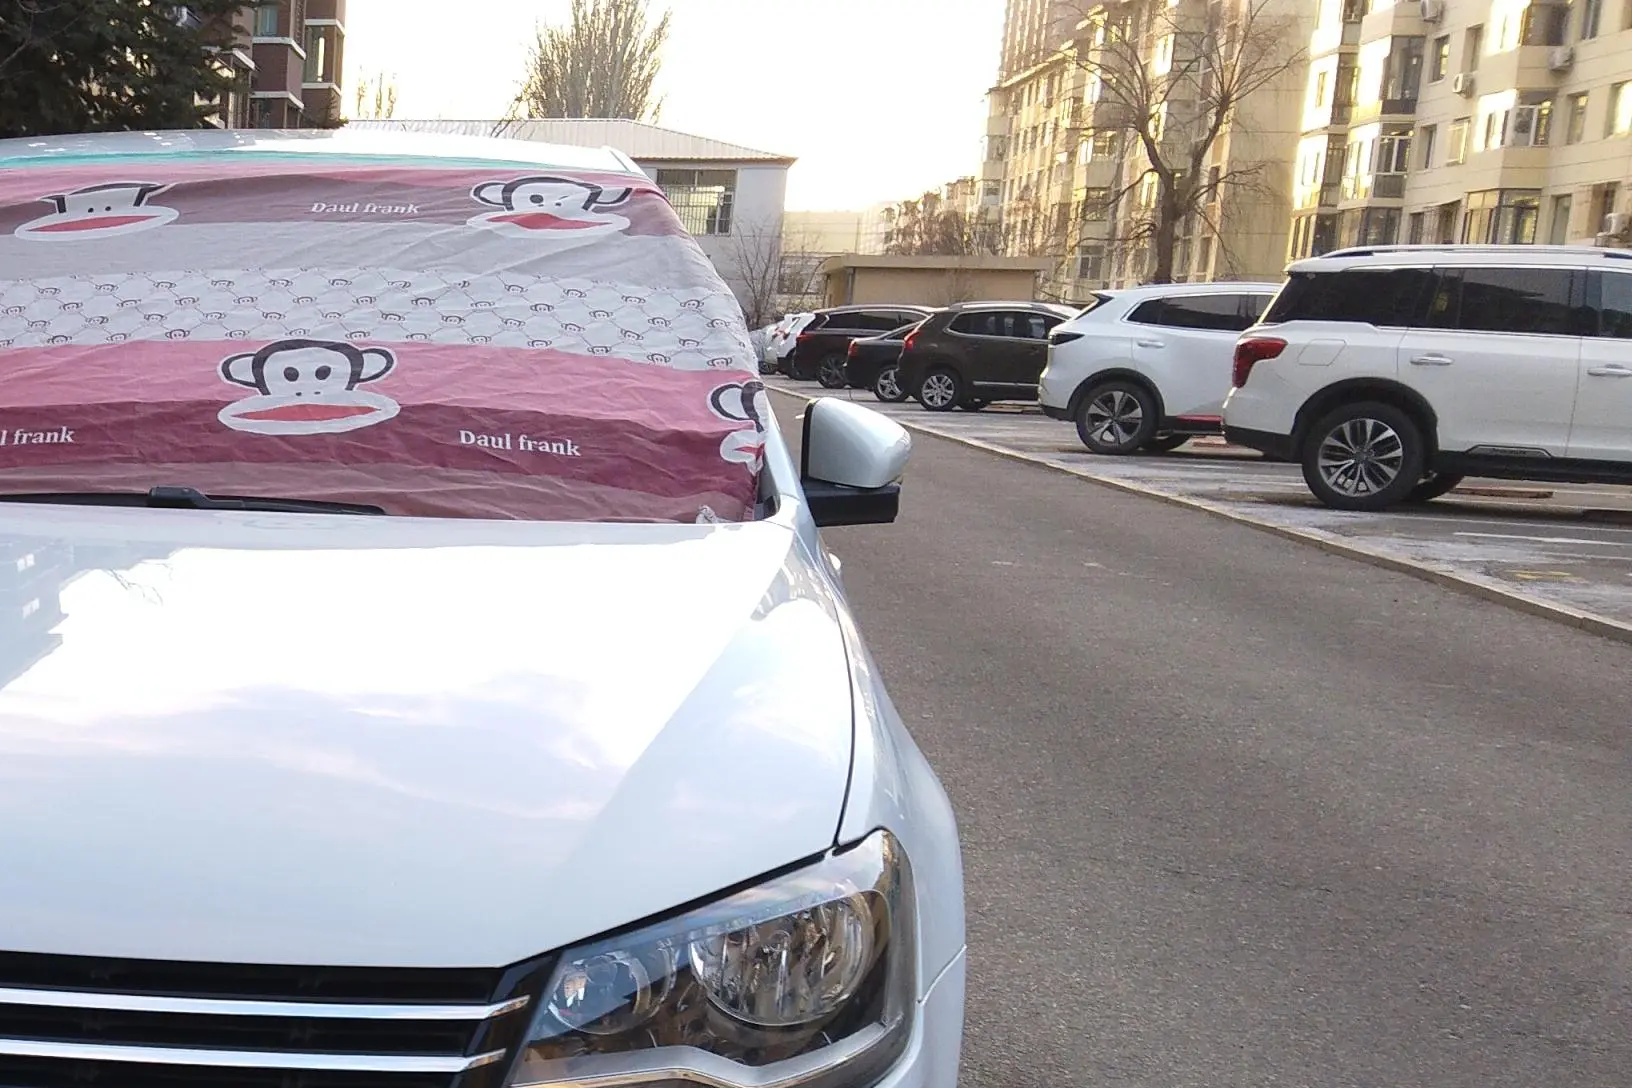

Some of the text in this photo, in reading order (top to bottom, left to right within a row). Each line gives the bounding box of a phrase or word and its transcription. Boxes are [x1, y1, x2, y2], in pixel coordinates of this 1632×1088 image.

[311, 202, 420, 214] Daul frank
[12, 425, 75, 446] frank
[459, 430, 582, 456] Daul frank
